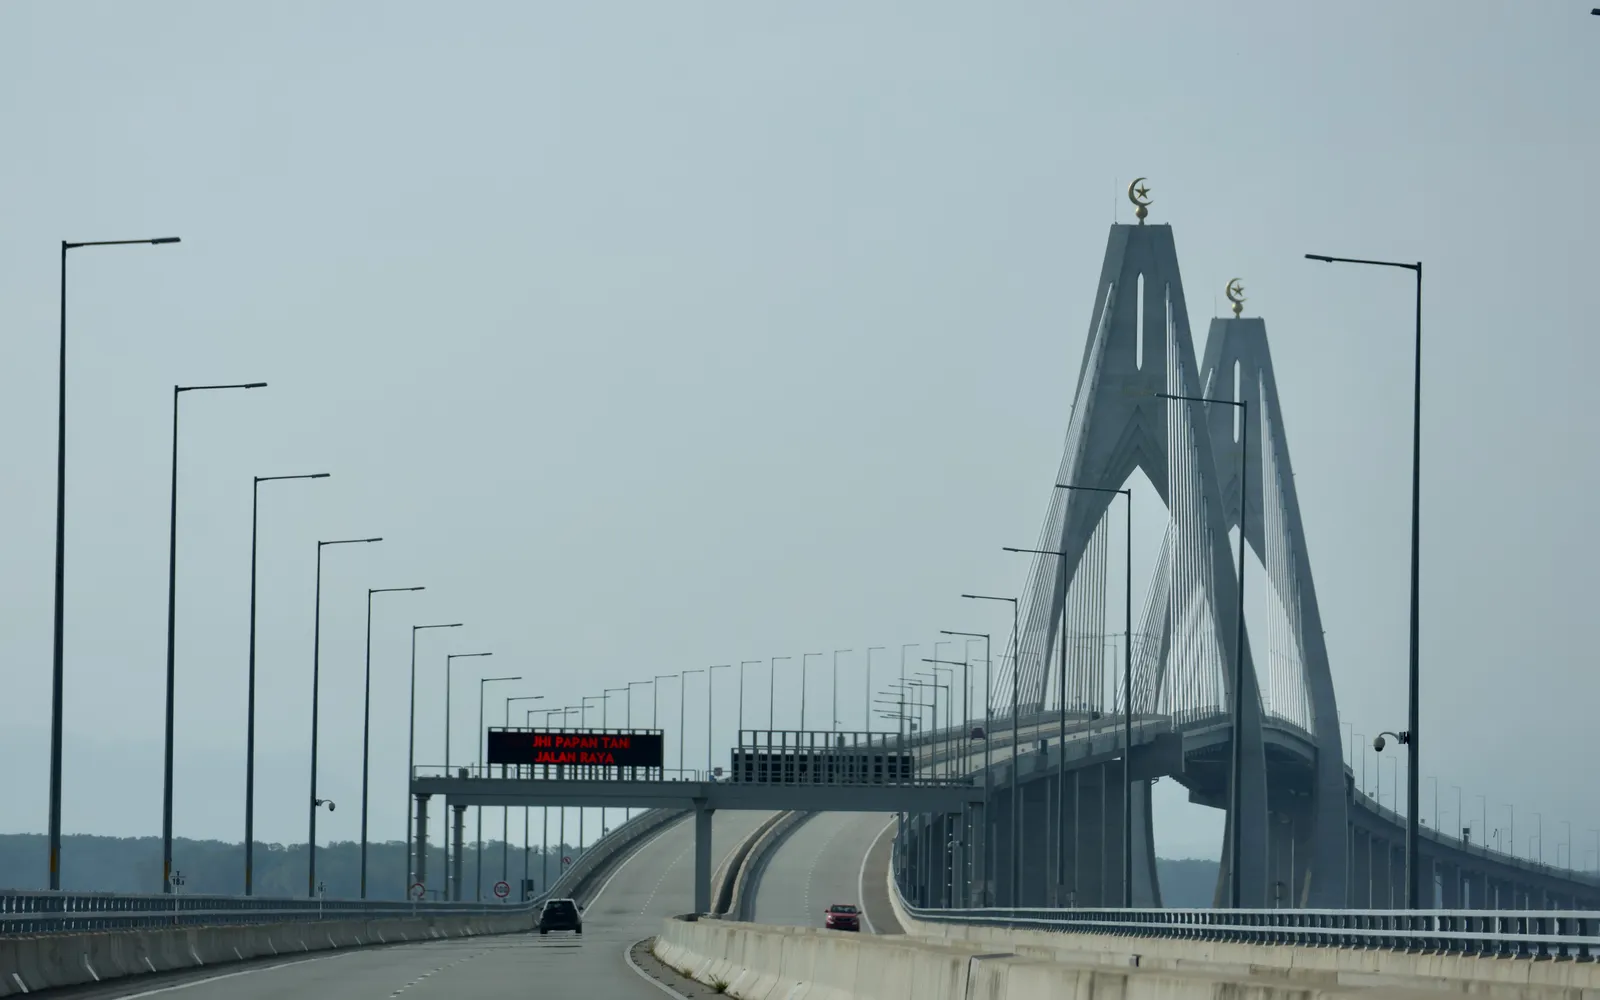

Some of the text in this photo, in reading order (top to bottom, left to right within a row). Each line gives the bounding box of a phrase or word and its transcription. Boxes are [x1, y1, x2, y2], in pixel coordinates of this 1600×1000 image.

[555, 736, 598, 748] PAPAN
[534, 751, 615, 764] JALAN RAYA
